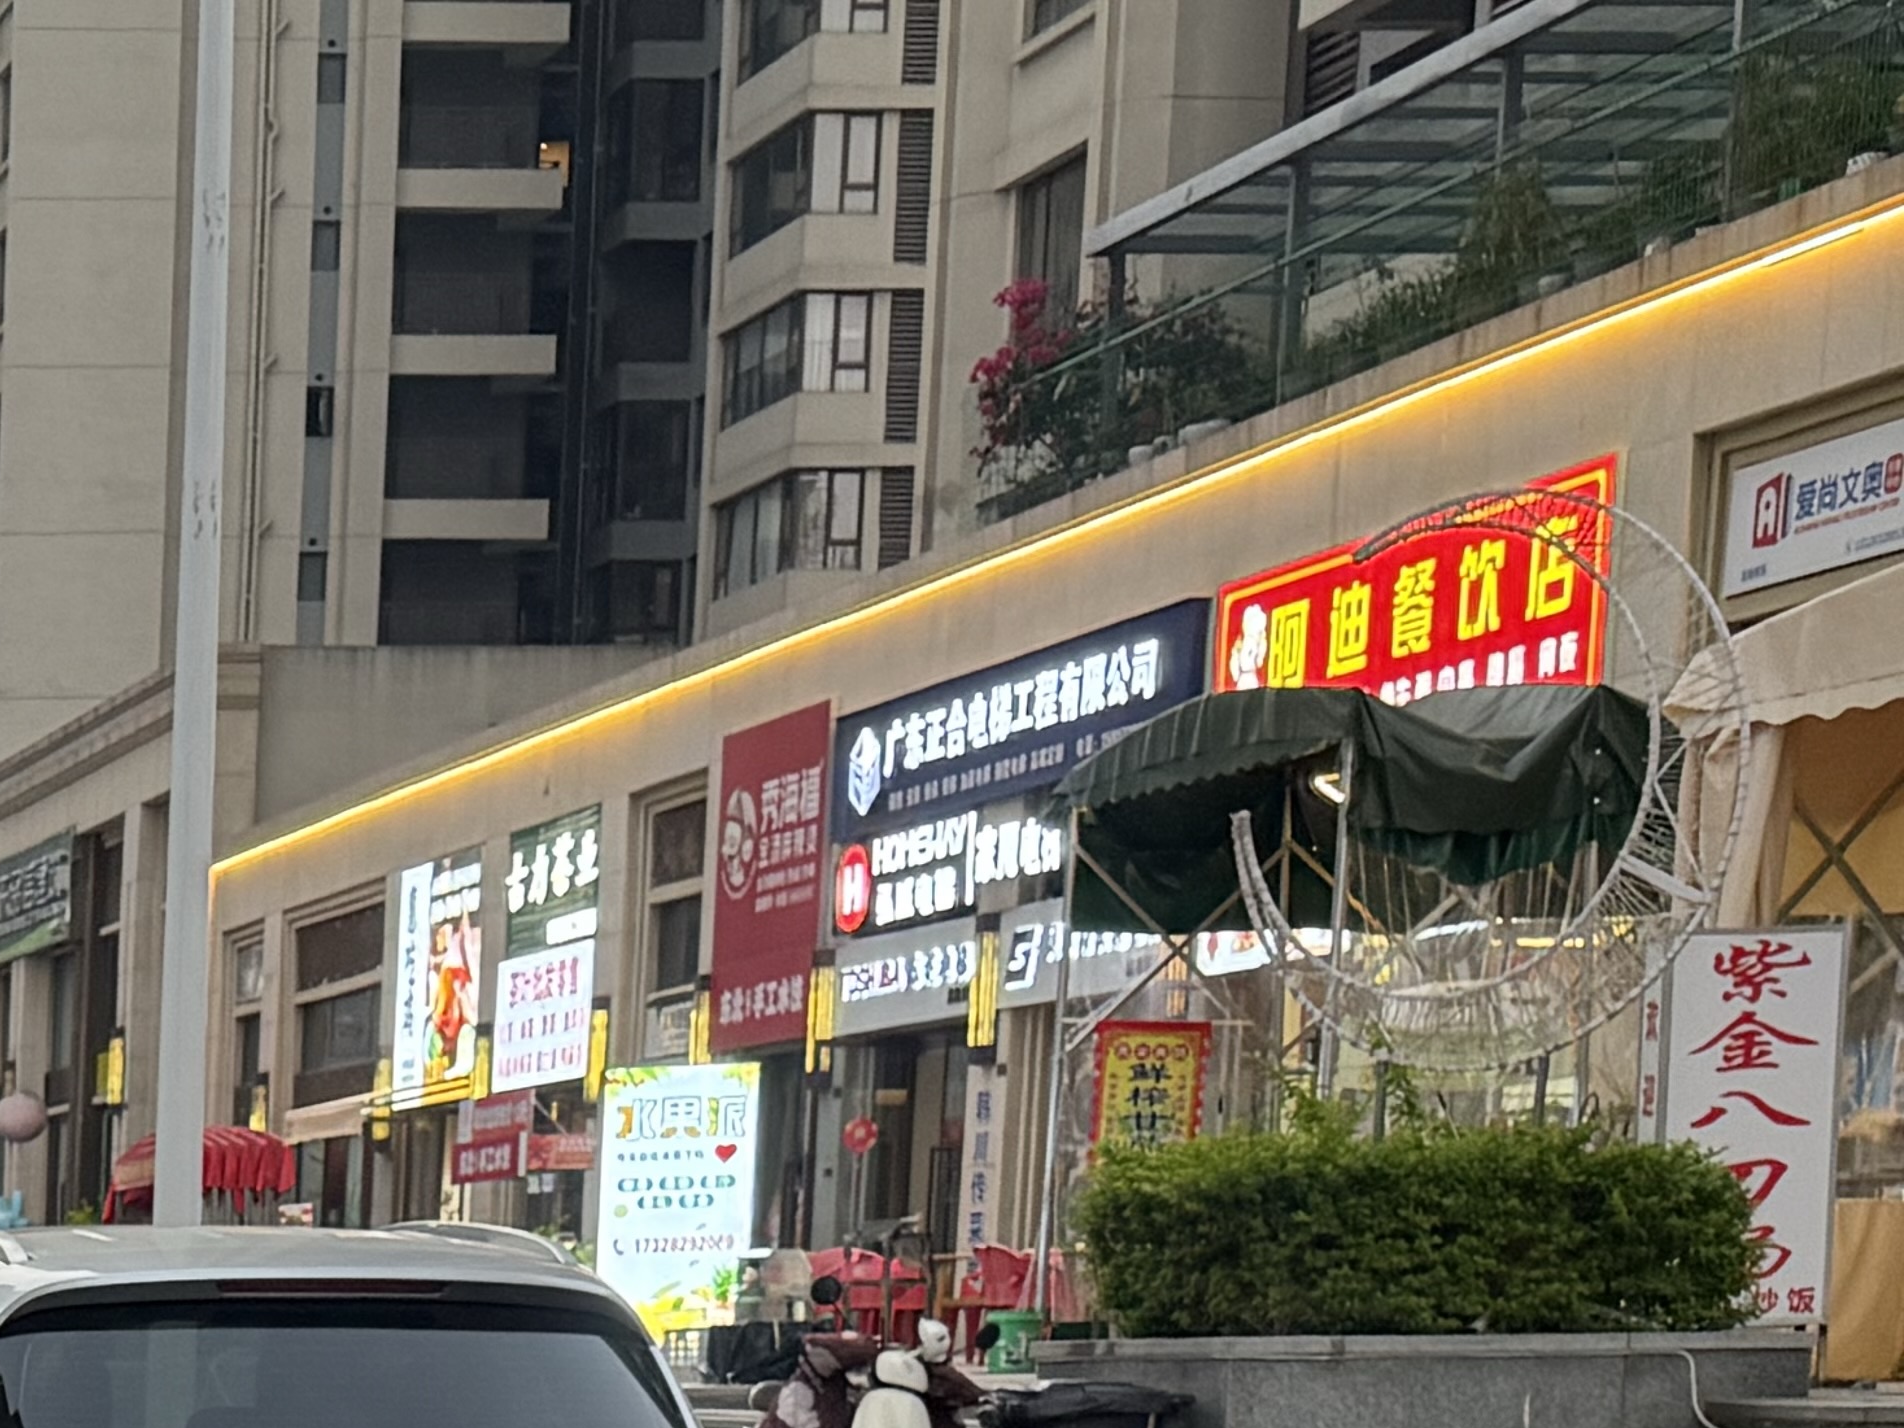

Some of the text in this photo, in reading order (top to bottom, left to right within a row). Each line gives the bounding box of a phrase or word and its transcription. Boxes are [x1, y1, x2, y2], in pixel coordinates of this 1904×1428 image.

[1269, 514, 1580, 689] 阿迪餐饮店
